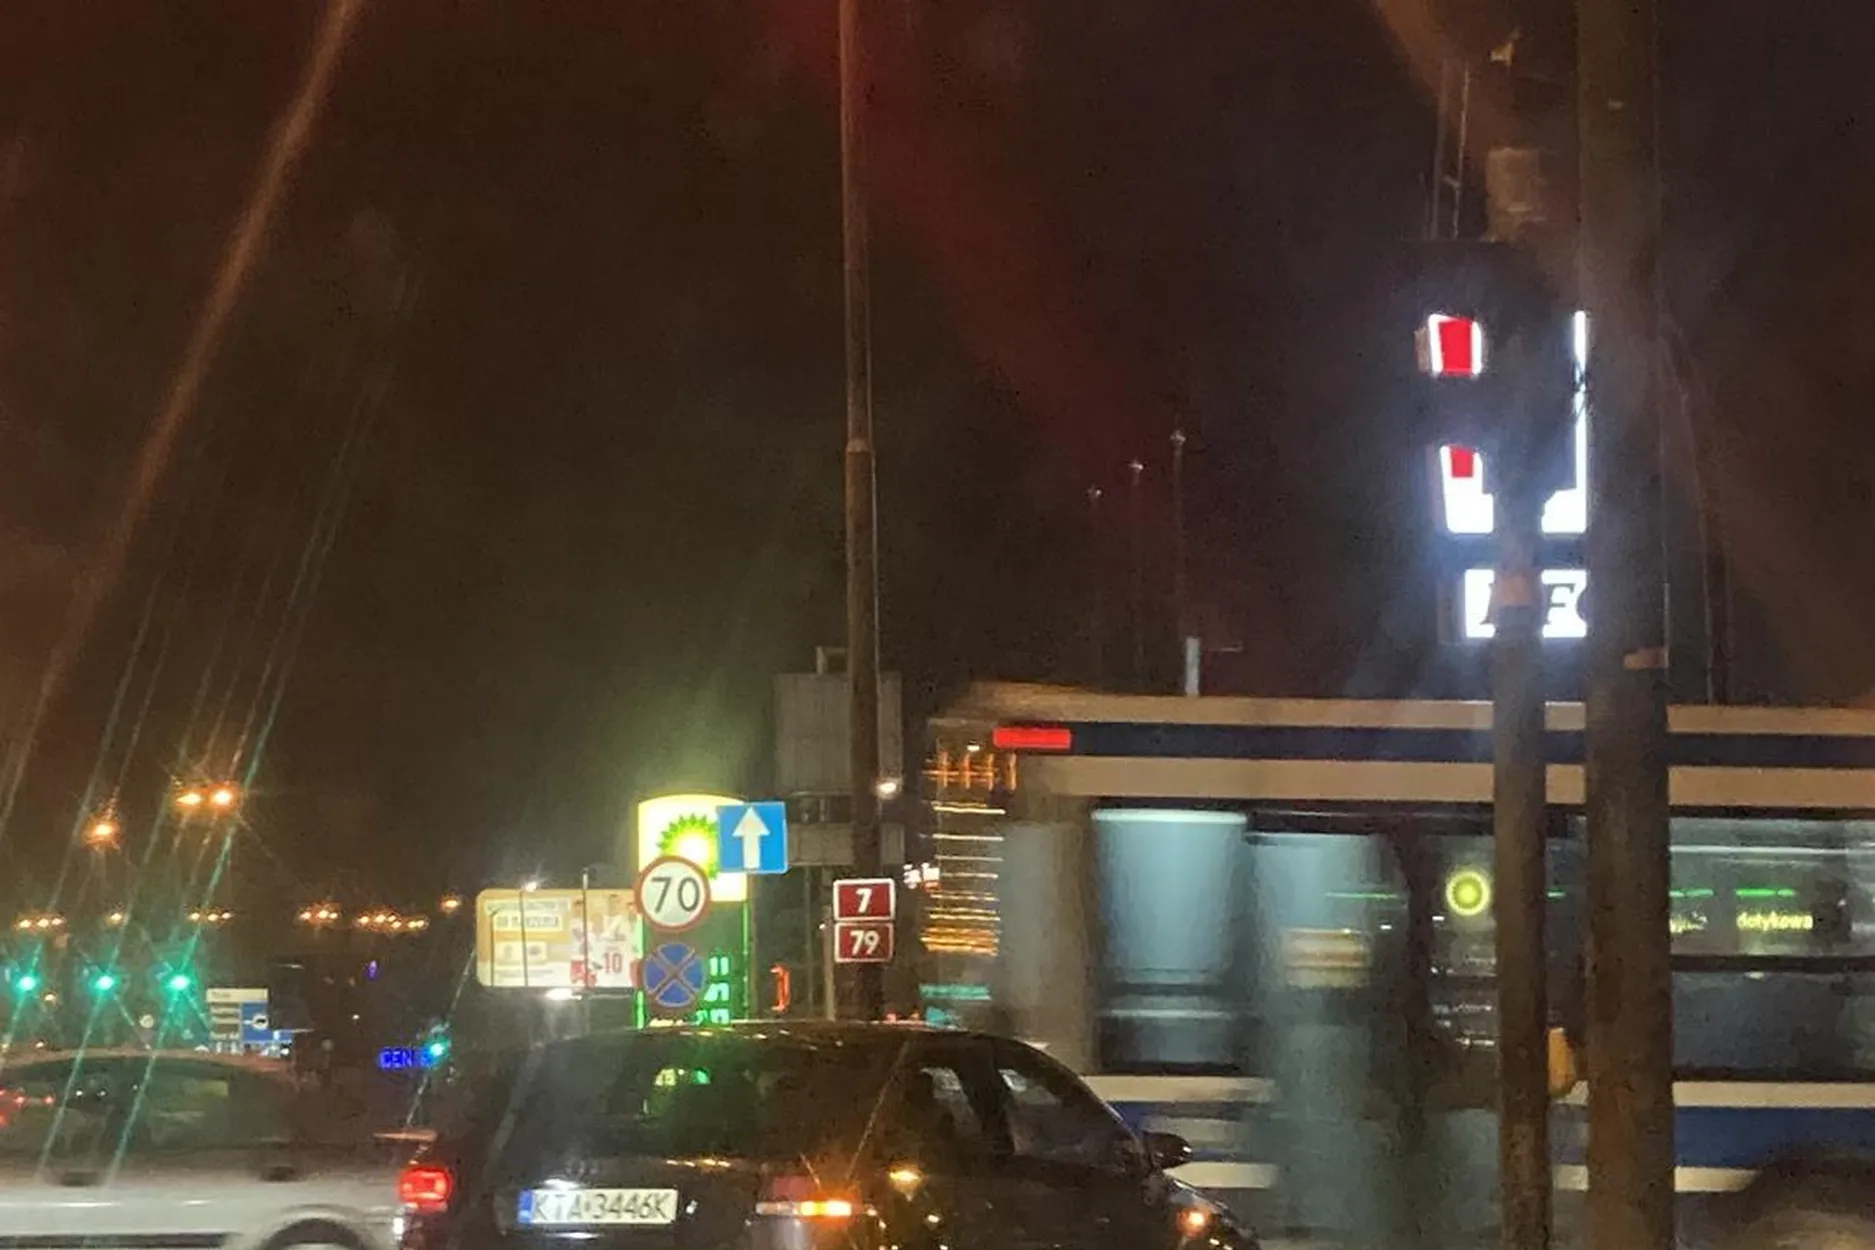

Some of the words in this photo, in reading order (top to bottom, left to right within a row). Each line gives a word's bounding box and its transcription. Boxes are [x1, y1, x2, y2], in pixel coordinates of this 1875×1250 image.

[652, 877, 700, 912] 70
[855, 887, 873, 914] 7
[849, 929, 880, 956] 79
